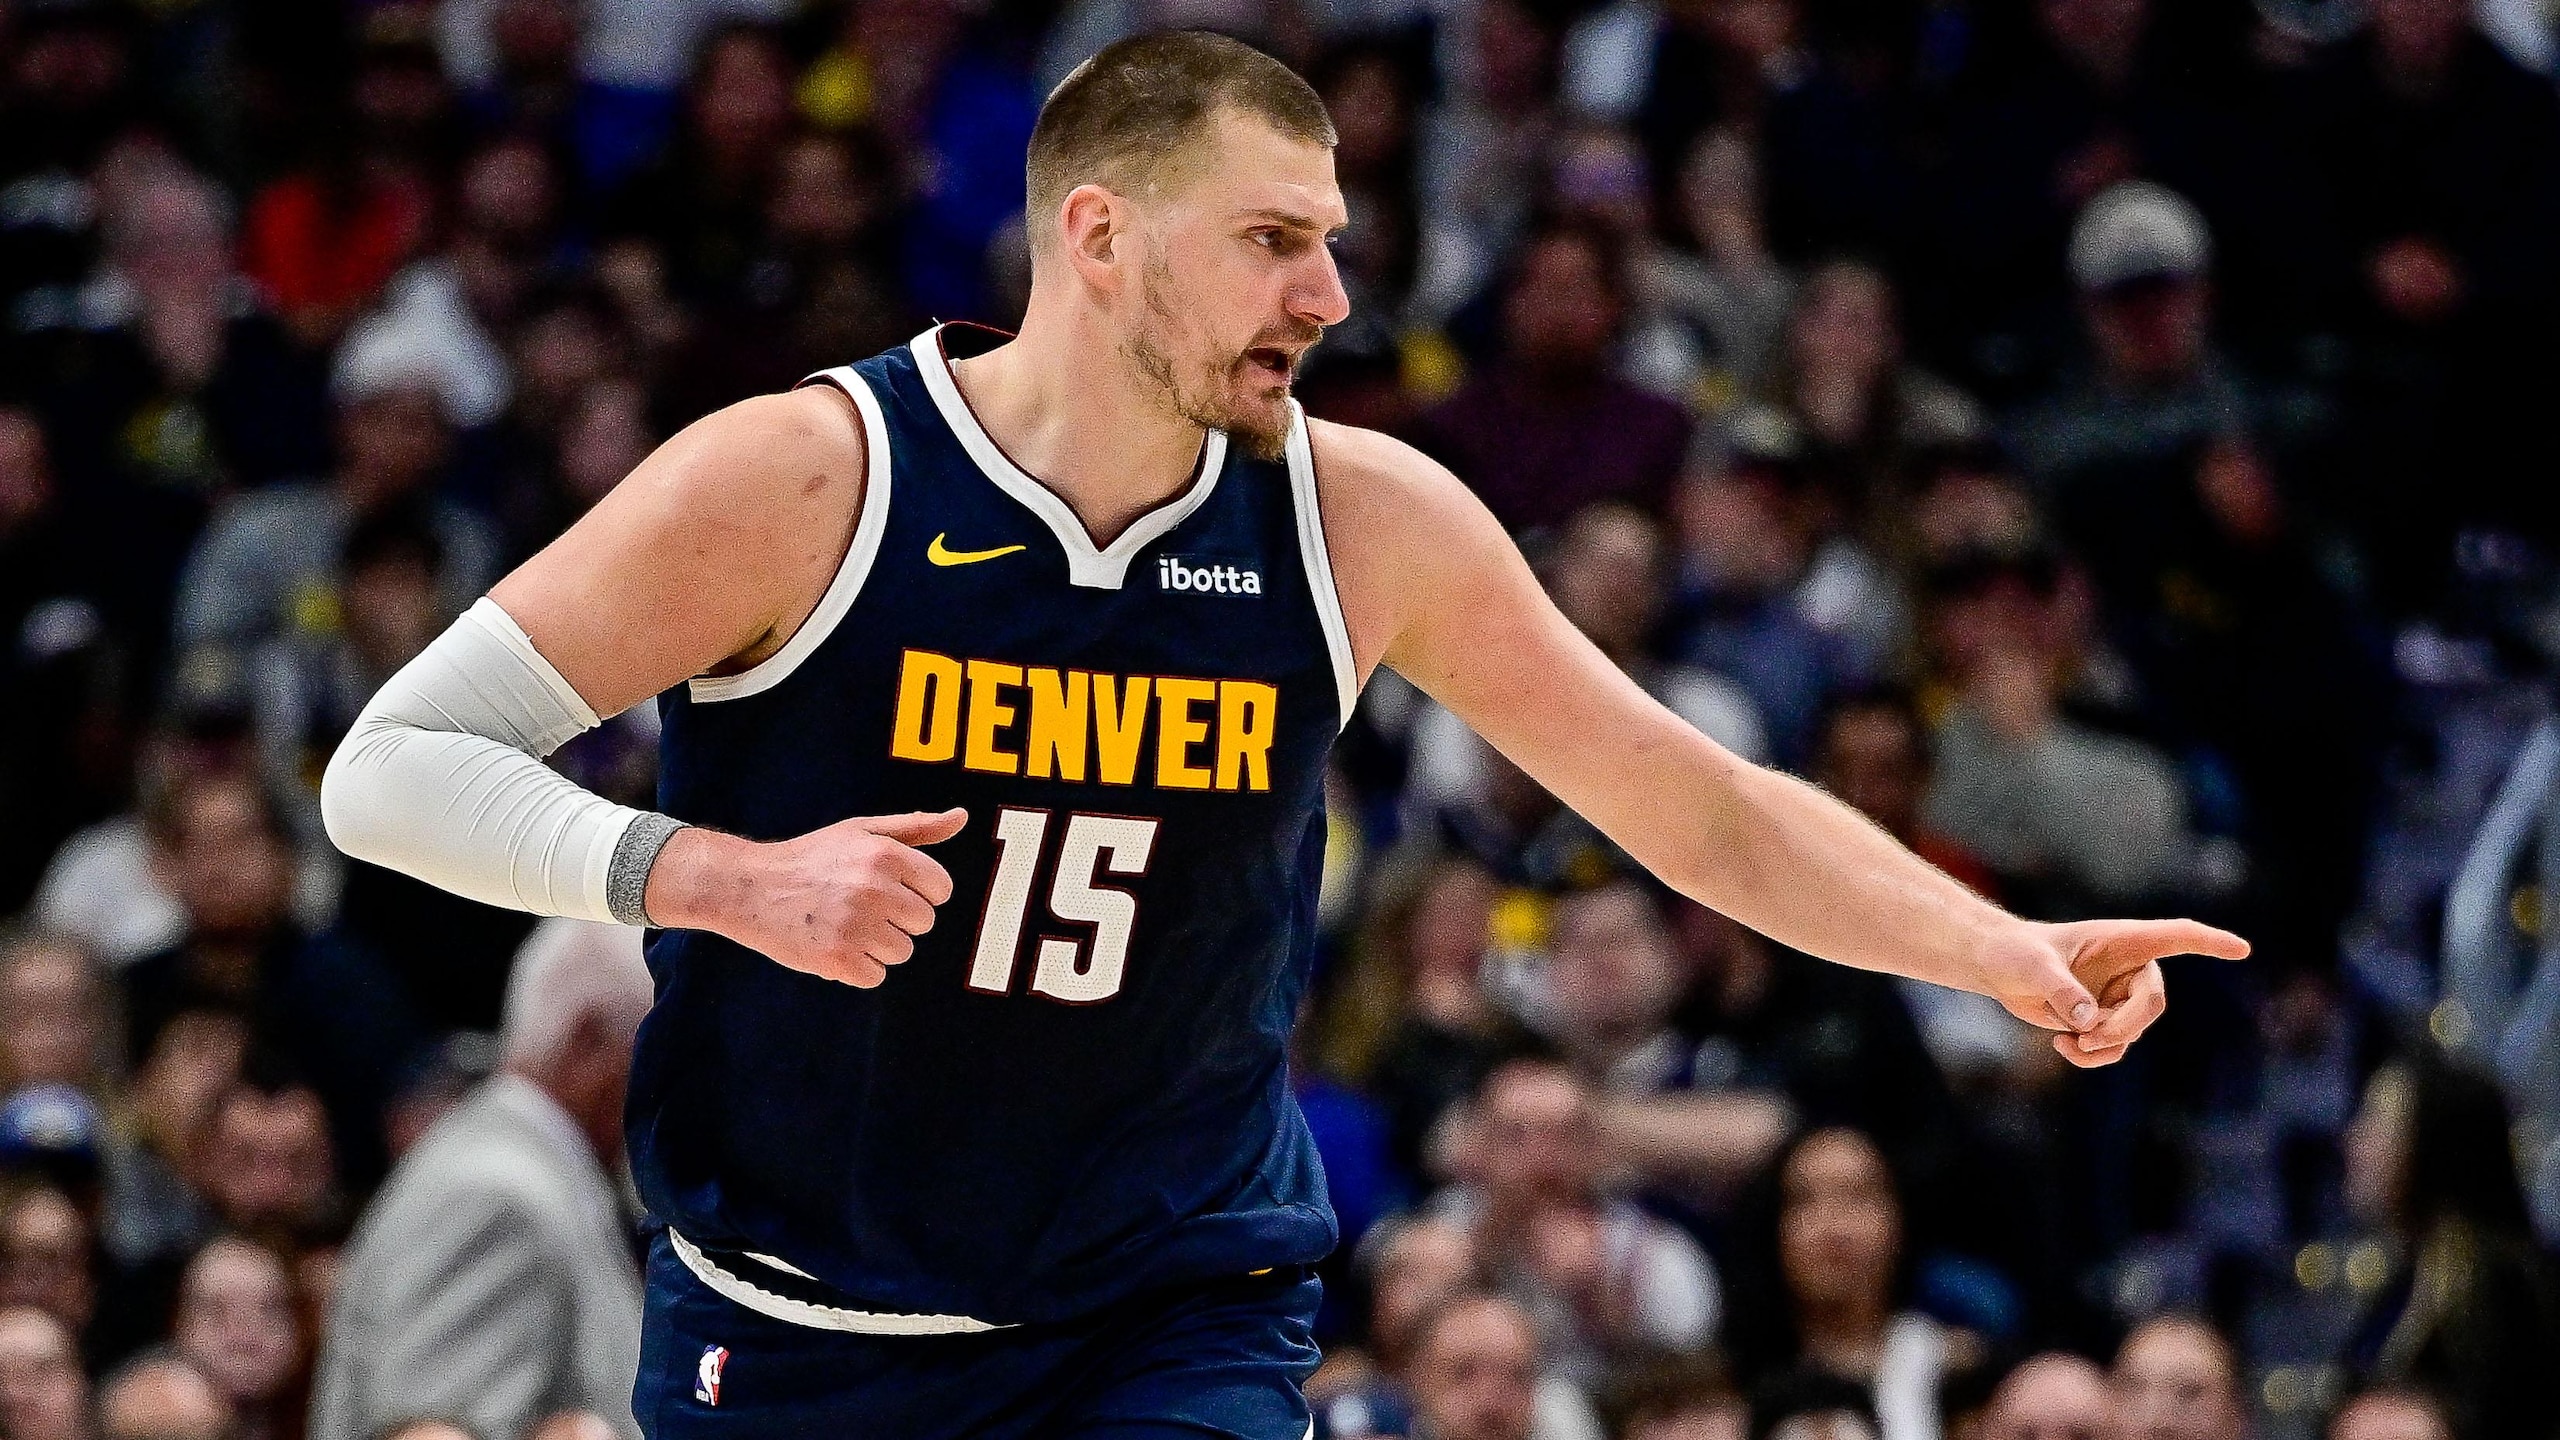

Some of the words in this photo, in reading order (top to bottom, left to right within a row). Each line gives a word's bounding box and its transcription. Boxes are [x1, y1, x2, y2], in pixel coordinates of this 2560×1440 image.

[1159, 559, 1262, 595] ibotta
[890, 649, 1278, 792] DENVER
[966, 805, 1162, 1004] 15
